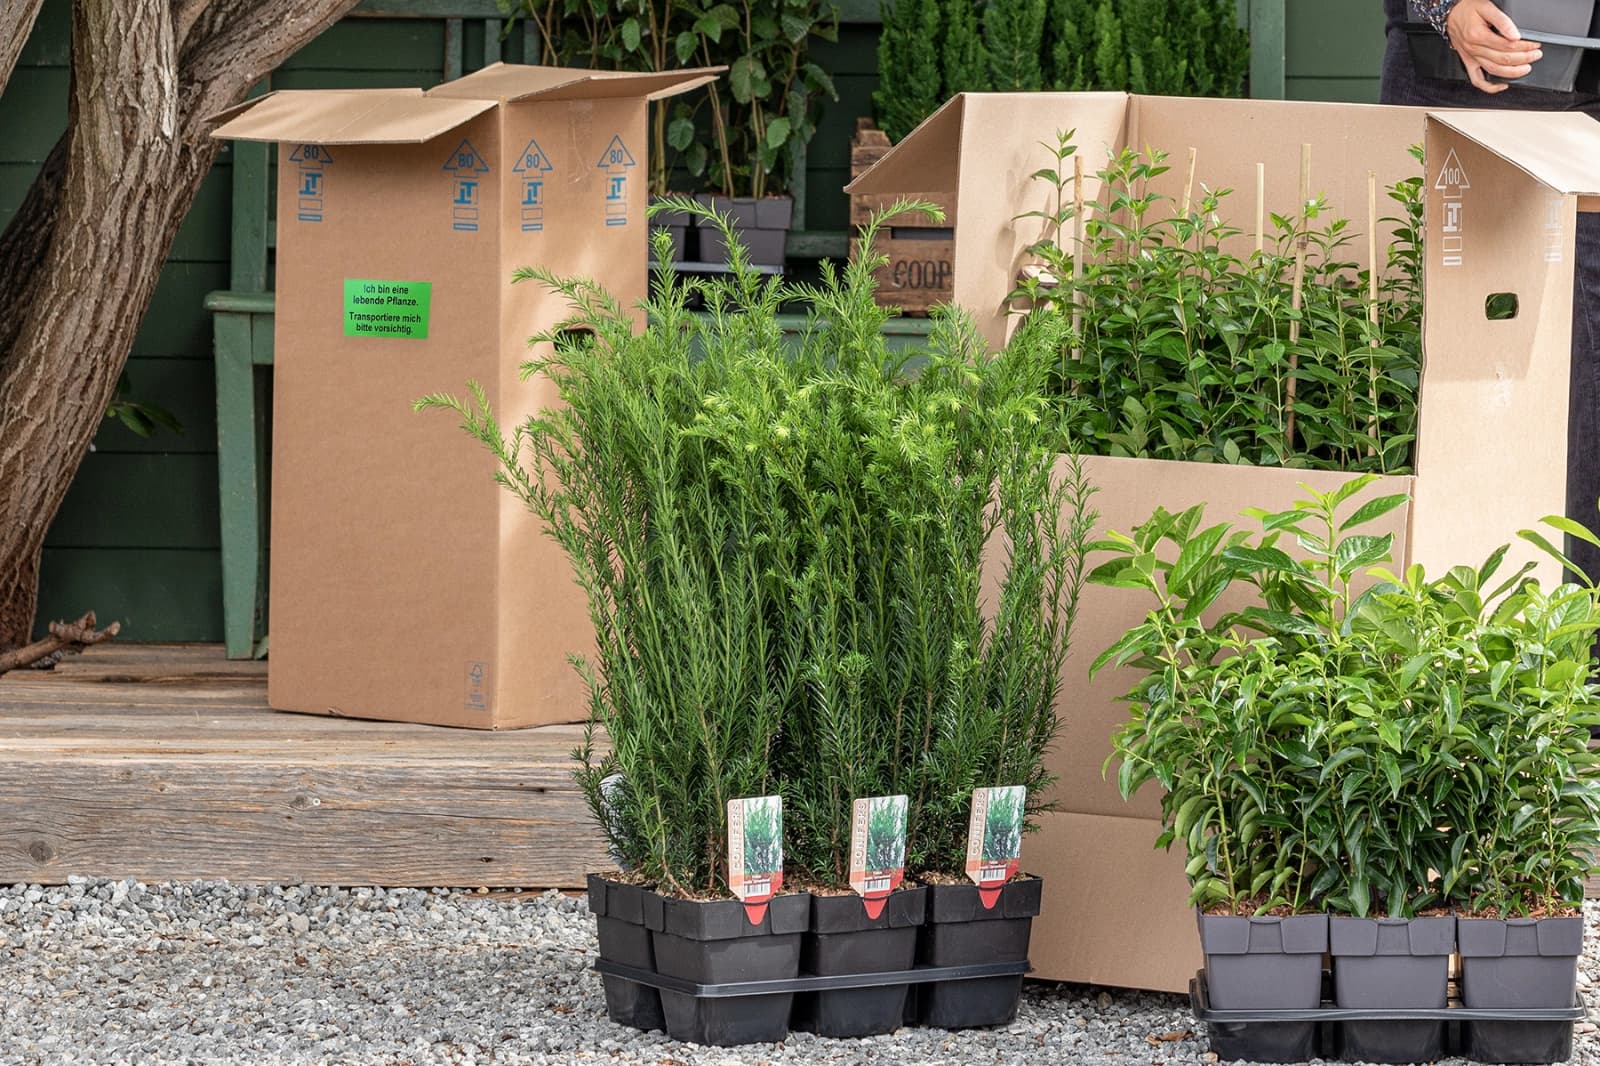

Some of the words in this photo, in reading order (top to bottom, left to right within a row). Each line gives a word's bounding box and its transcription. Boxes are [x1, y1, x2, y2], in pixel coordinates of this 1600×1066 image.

[303, 144, 320, 160] 80
[609, 149, 623, 164] 80
[458, 153, 474, 168] 80
[526, 153, 540, 169] 80
[1444, 167, 1459, 185] 100
[894, 260, 952, 289] COOP
[363, 284, 376, 293] Ich
[377, 284, 390, 293] bin
[391, 285, 409, 294] eine
[353, 295, 385, 305] lebende
[386, 296, 419, 306] Pflanze.
[348, 312, 401, 323] Transportiere
[402, 313, 421, 323] mich
[355, 323, 373, 332] bitte
[374, 324, 413, 335] vorsichtig.
[970, 791, 986, 856] CONIFERS
[731, 803, 742, 870] CONIFERS
[854, 801, 867, 867] CONIFERS
